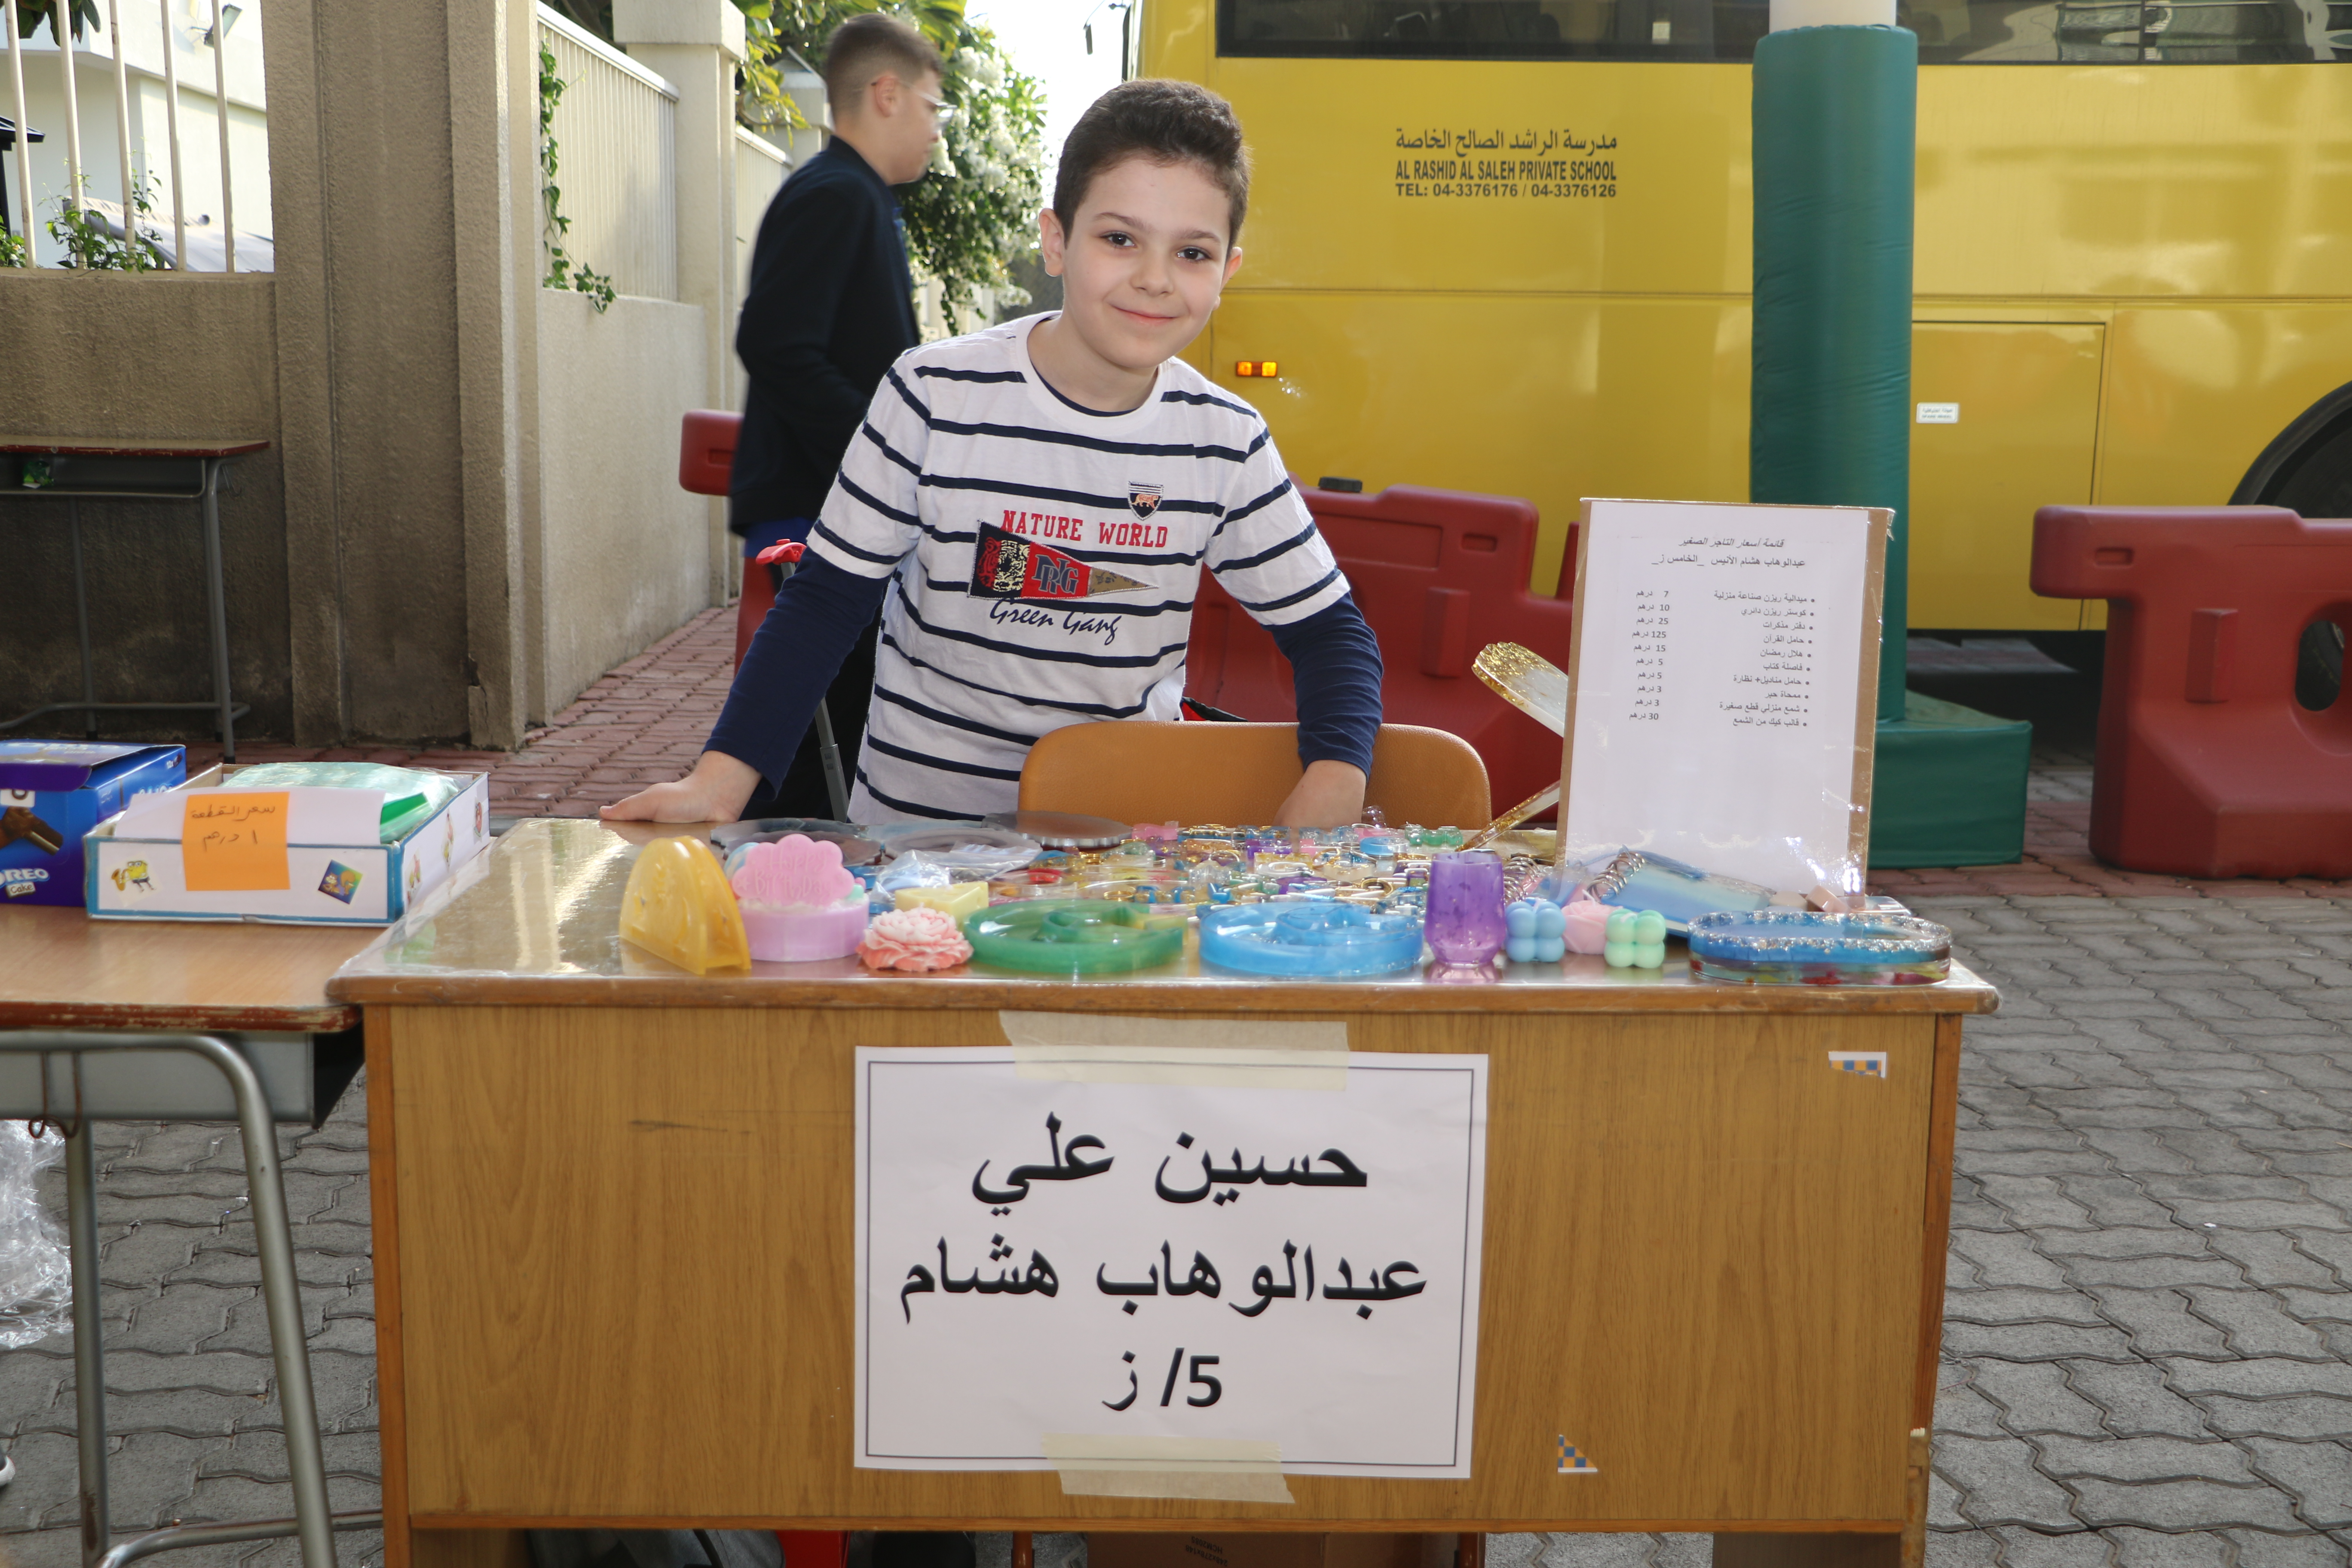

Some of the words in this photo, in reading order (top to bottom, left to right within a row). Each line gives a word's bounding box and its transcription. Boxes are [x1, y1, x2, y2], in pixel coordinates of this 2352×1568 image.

[1396, 128, 1450, 149] الخاصة
[1456, 129, 1504, 157] الصالح
[1510, 129, 1558, 156] الراشد
[1564, 129, 1617, 156] مدرسة
[1396, 160, 1409, 180] AL
[1414, 160, 1456, 180] RASHID
[1460, 160, 1473, 180] AL
[1478, 161, 1515, 180] SALEH
[1519, 161, 1566, 180] PRIVATE
[1570, 161, 1616, 181] SCHOOL
[1396, 184, 1427, 196] TEL:
[1433, 184, 1518, 197] 04-3376176
[1531, 184, 1616, 197] 04-3376126
[1000, 510, 1083, 541] NATURE
[1099, 522, 1168, 548] WORLD
[1678, 537, 1708, 546] الصغير
[1709, 538, 1734, 548] التاجر
[1736, 538, 1761, 548] أسعار
[1762, 539, 1784, 547] قائمة
[1740, 557, 1760, 567] هشام
[1764, 557, 1805, 568] عبدالوهاب
[1636, 590, 1653, 598] درهم
[1714, 591, 1735, 600] منزلية
[1738, 591, 1761, 600] صناعة
[1784, 593, 1807, 603] ميدالية
[1784, 609, 1806, 617] كوستر
[989, 599, 1054, 627] Green
[1063, 611, 1122, 645] Gang
[1763, 621, 1788, 629] مذكرات
[1791, 622, 1805, 630] دفتر
[1764, 634, 1784, 643] القرآن
[1760, 649, 1785, 658] رمضان
[1782, 662, 1802, 671] فاصلة
[1733, 675, 1752, 683] نظارة
[1637, 685, 1654, 693] درهم
[1635, 699, 1652, 707] درهم
[1719, 701, 1742, 710] صغيرة
[1745, 703, 1758, 712] قطع
[1761, 704, 1781, 713] منزلي
[1783, 705, 1799, 714] شمع
[1629, 712, 1646, 720] درهم
[1733, 717, 1752, 726] الشمع
[1784, 718, 1799, 727] قالب
[191, 804, 239, 818] القطعة
[232, 806, 275, 821] سعر
[203, 831, 239, 851] درهم
[767, 845, 828, 873] Happy
[10, 884, 34, 894] Cake
[972, 1111, 1115, 1216] علي
[1155, 1131, 1367, 1206] حسين
[900, 1233, 1059, 1324] هشام
[1096, 1238, 1427, 1320] عبدالوهاب
